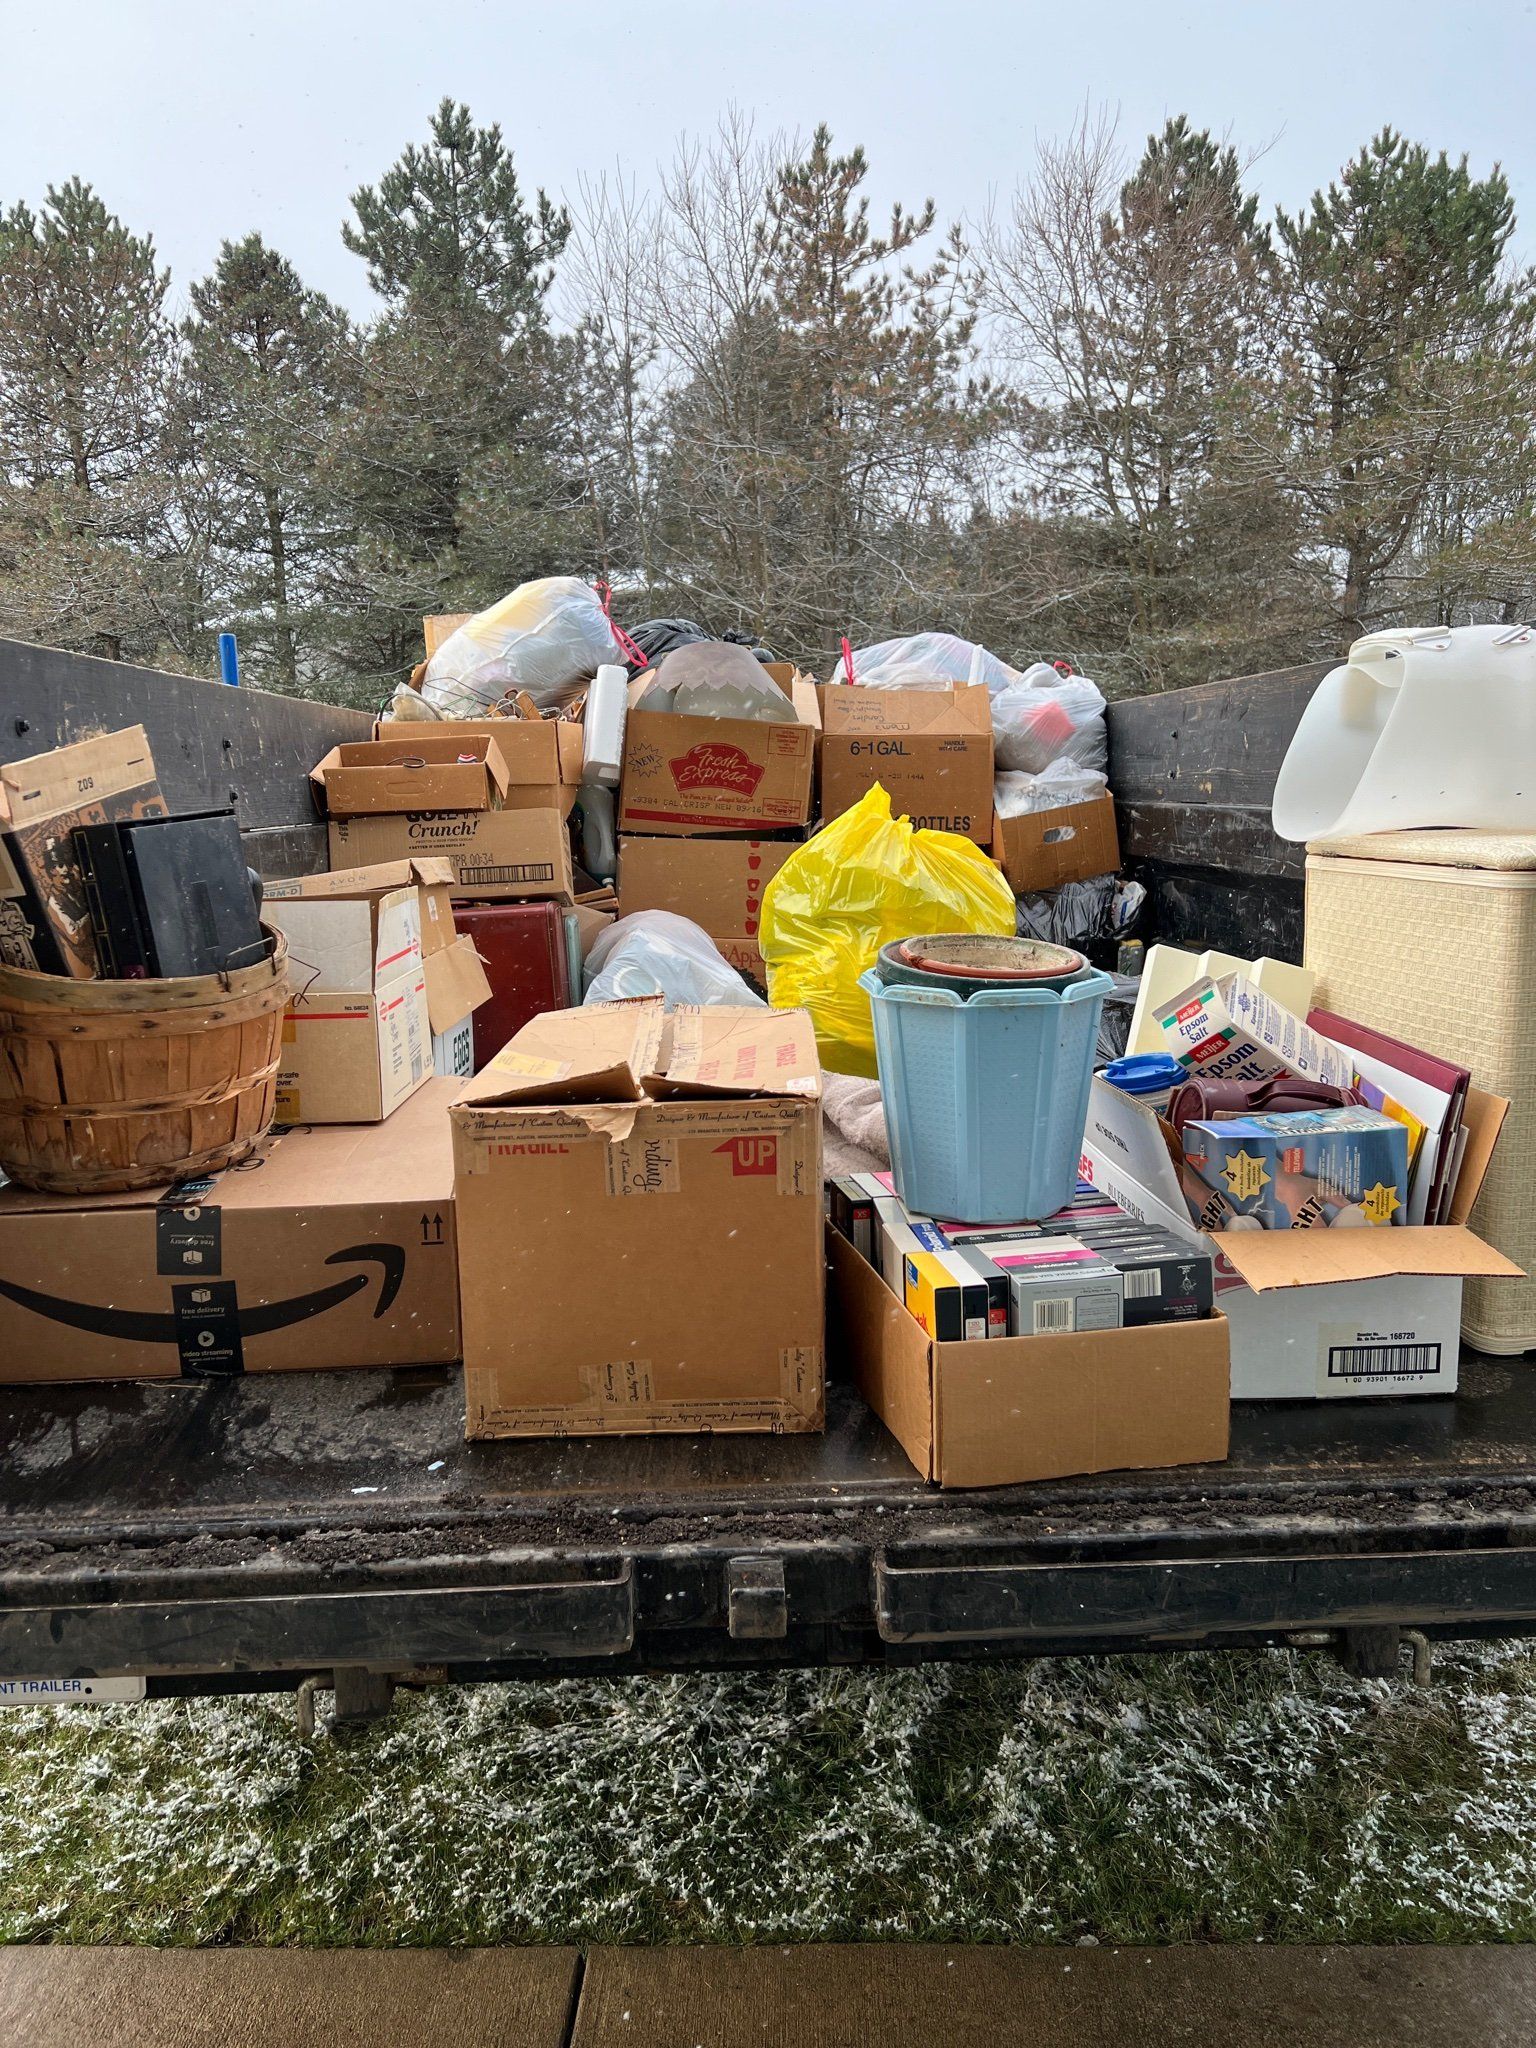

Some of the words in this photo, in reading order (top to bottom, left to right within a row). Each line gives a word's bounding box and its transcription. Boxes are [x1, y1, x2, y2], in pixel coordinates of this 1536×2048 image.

[635, 754, 656, 767] NEW
[694, 746, 748, 769] Fresh
[679, 763, 756, 783] Express
[77, 776, 95, 792] 602
[715, 803, 732, 811] NEW
[408, 820, 477, 838] Crunch!
[329, 874, 367, 887] AVON
[1178, 1012, 1209, 1037] Epsom
[1188, 1025, 1209, 1045] Salt
[454, 1027, 470, 1075] EGGS
[1194, 1042, 1259, 1079] Epsom
[1224, 1060, 1266, 1081] alt
[737, 1139, 776, 1167] UP
[1226, 1171, 1237, 1182] 4
[1366, 1199, 1375, 1208] 4
[170, 1238, 199, 1246] delivery
[200, 1239, 215, 1247] free
[197, 1306, 225, 1314] delivery
[181, 1350, 200, 1358] video
[201, 1348, 234, 1356] streaming
[21, 1680, 81, 1693] TRAILER
